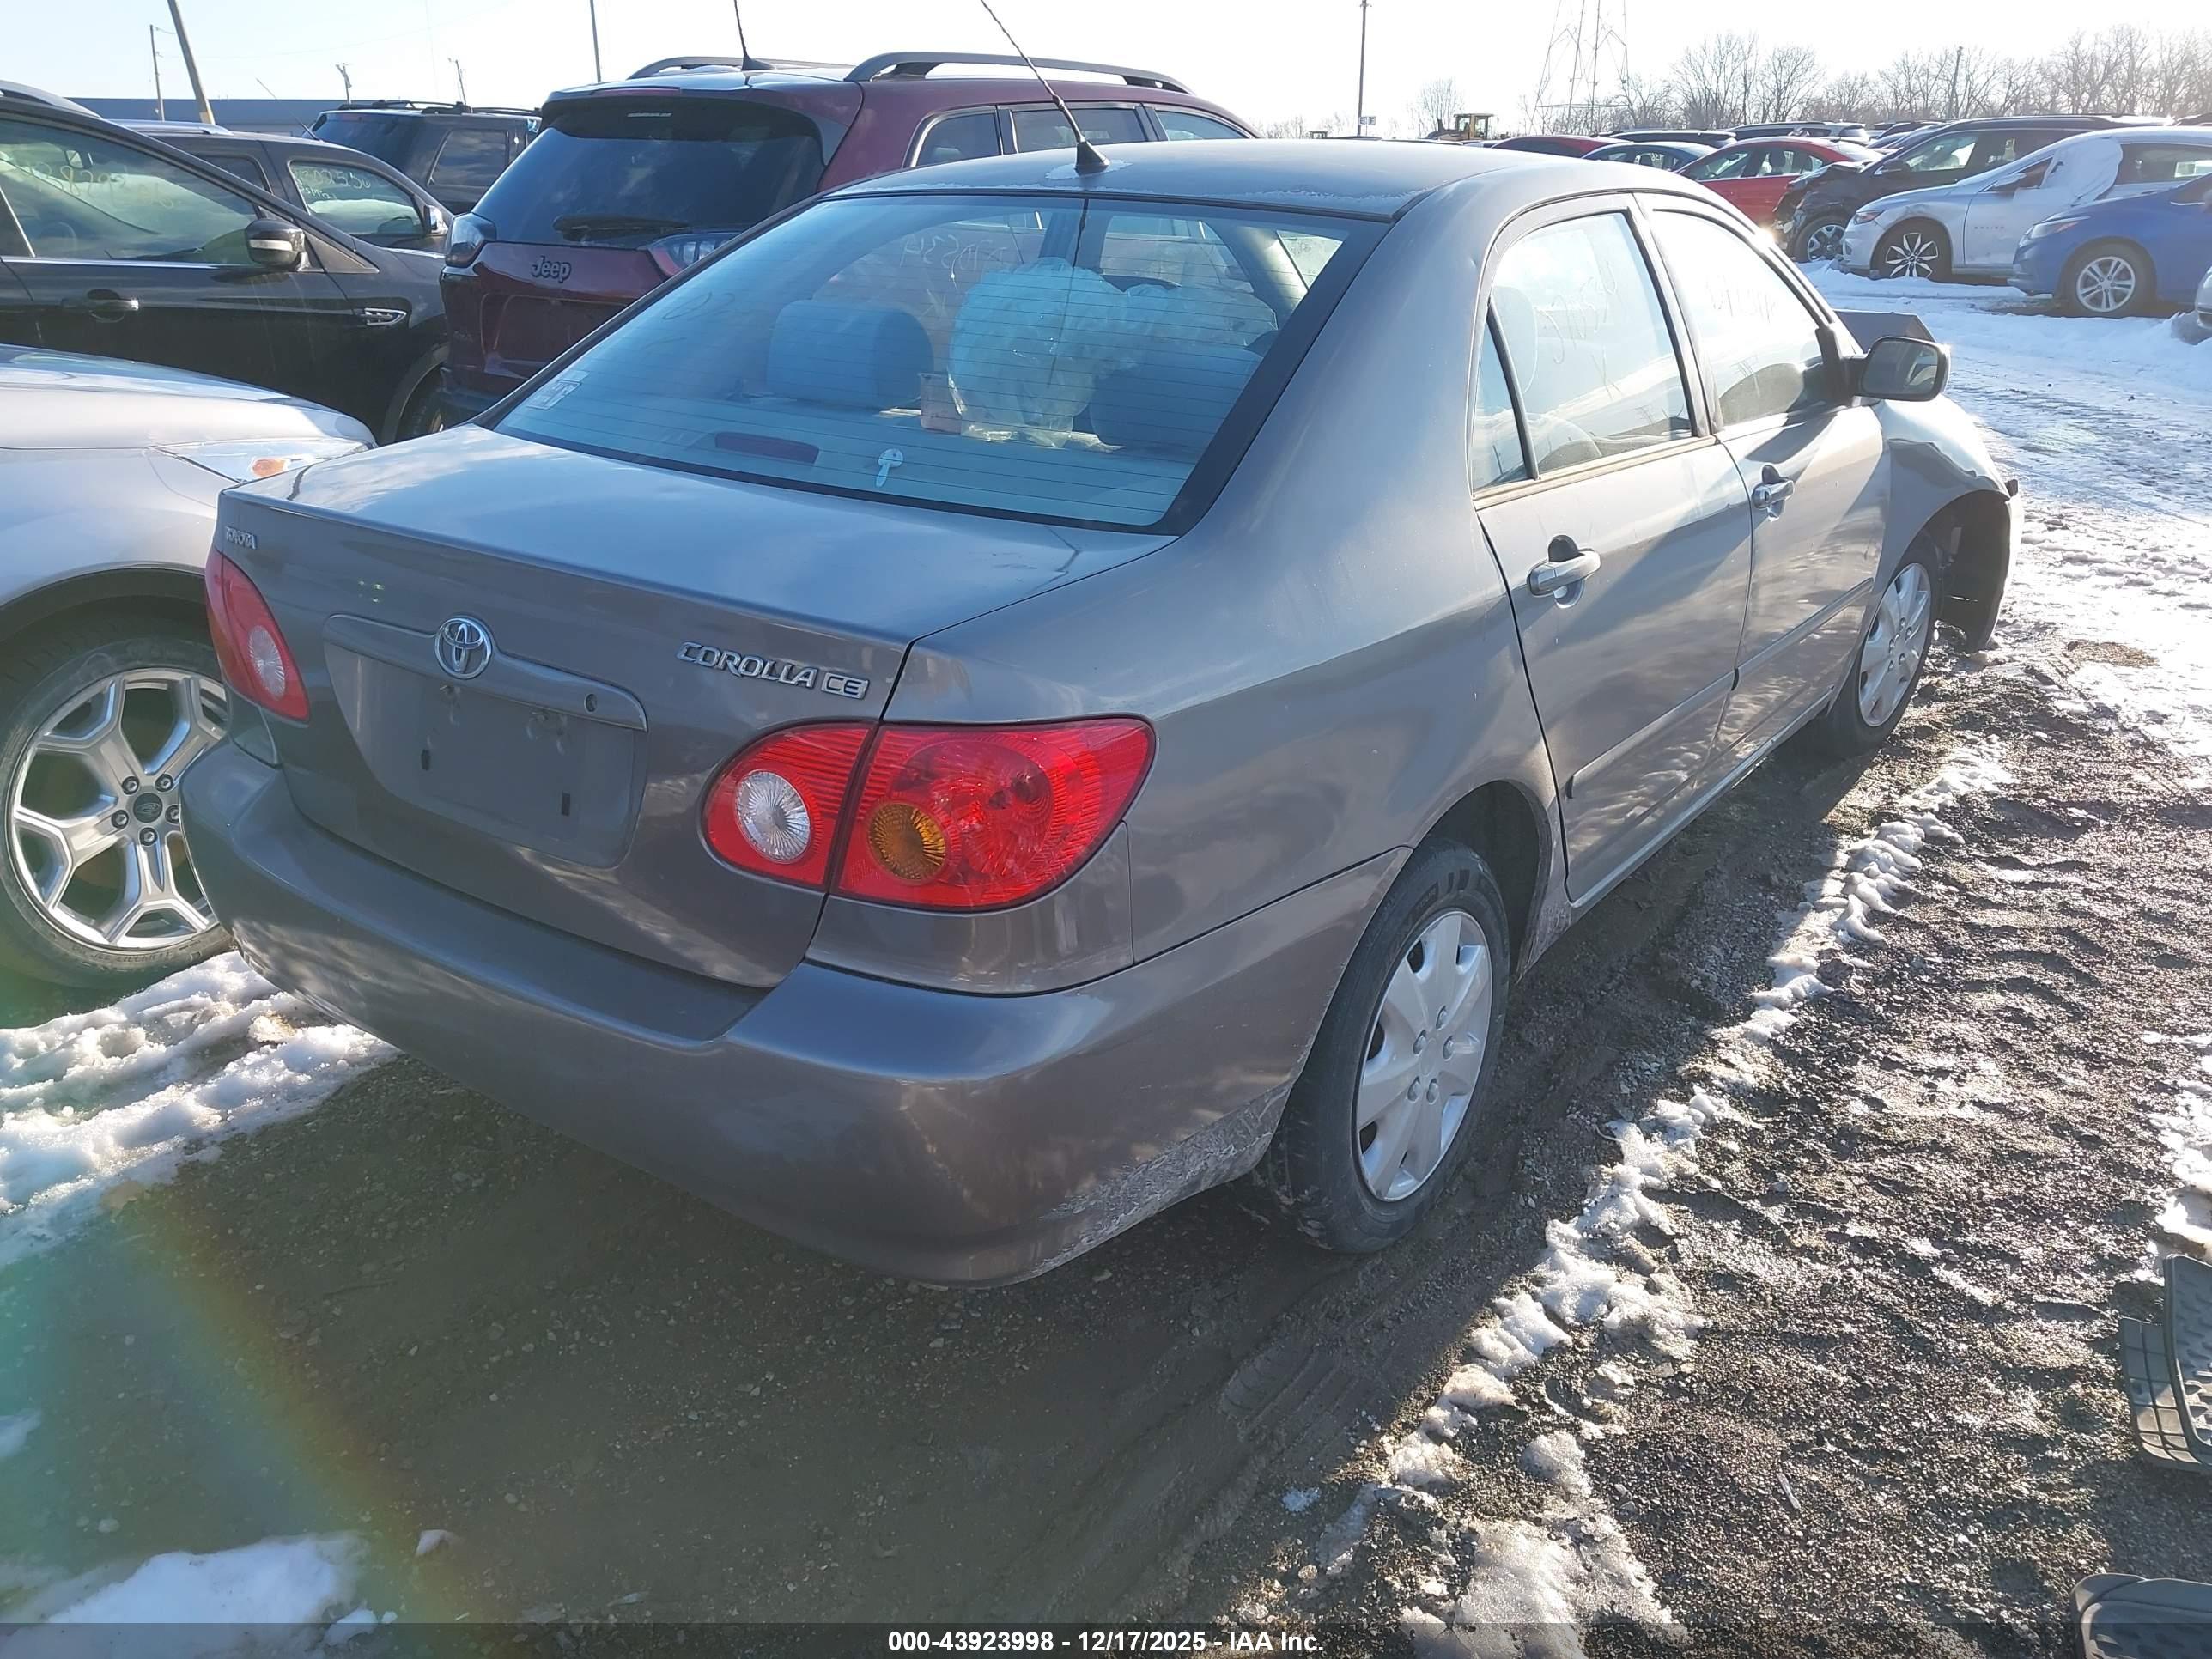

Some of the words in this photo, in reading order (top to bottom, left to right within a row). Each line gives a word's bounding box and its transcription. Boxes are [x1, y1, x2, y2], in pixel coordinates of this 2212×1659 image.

[531, 255, 571, 283] Jeep
[225, 525, 257, 550] TOYOTA
[676, 641, 817, 689] COROLLA
[823, 674, 866, 698] CE
